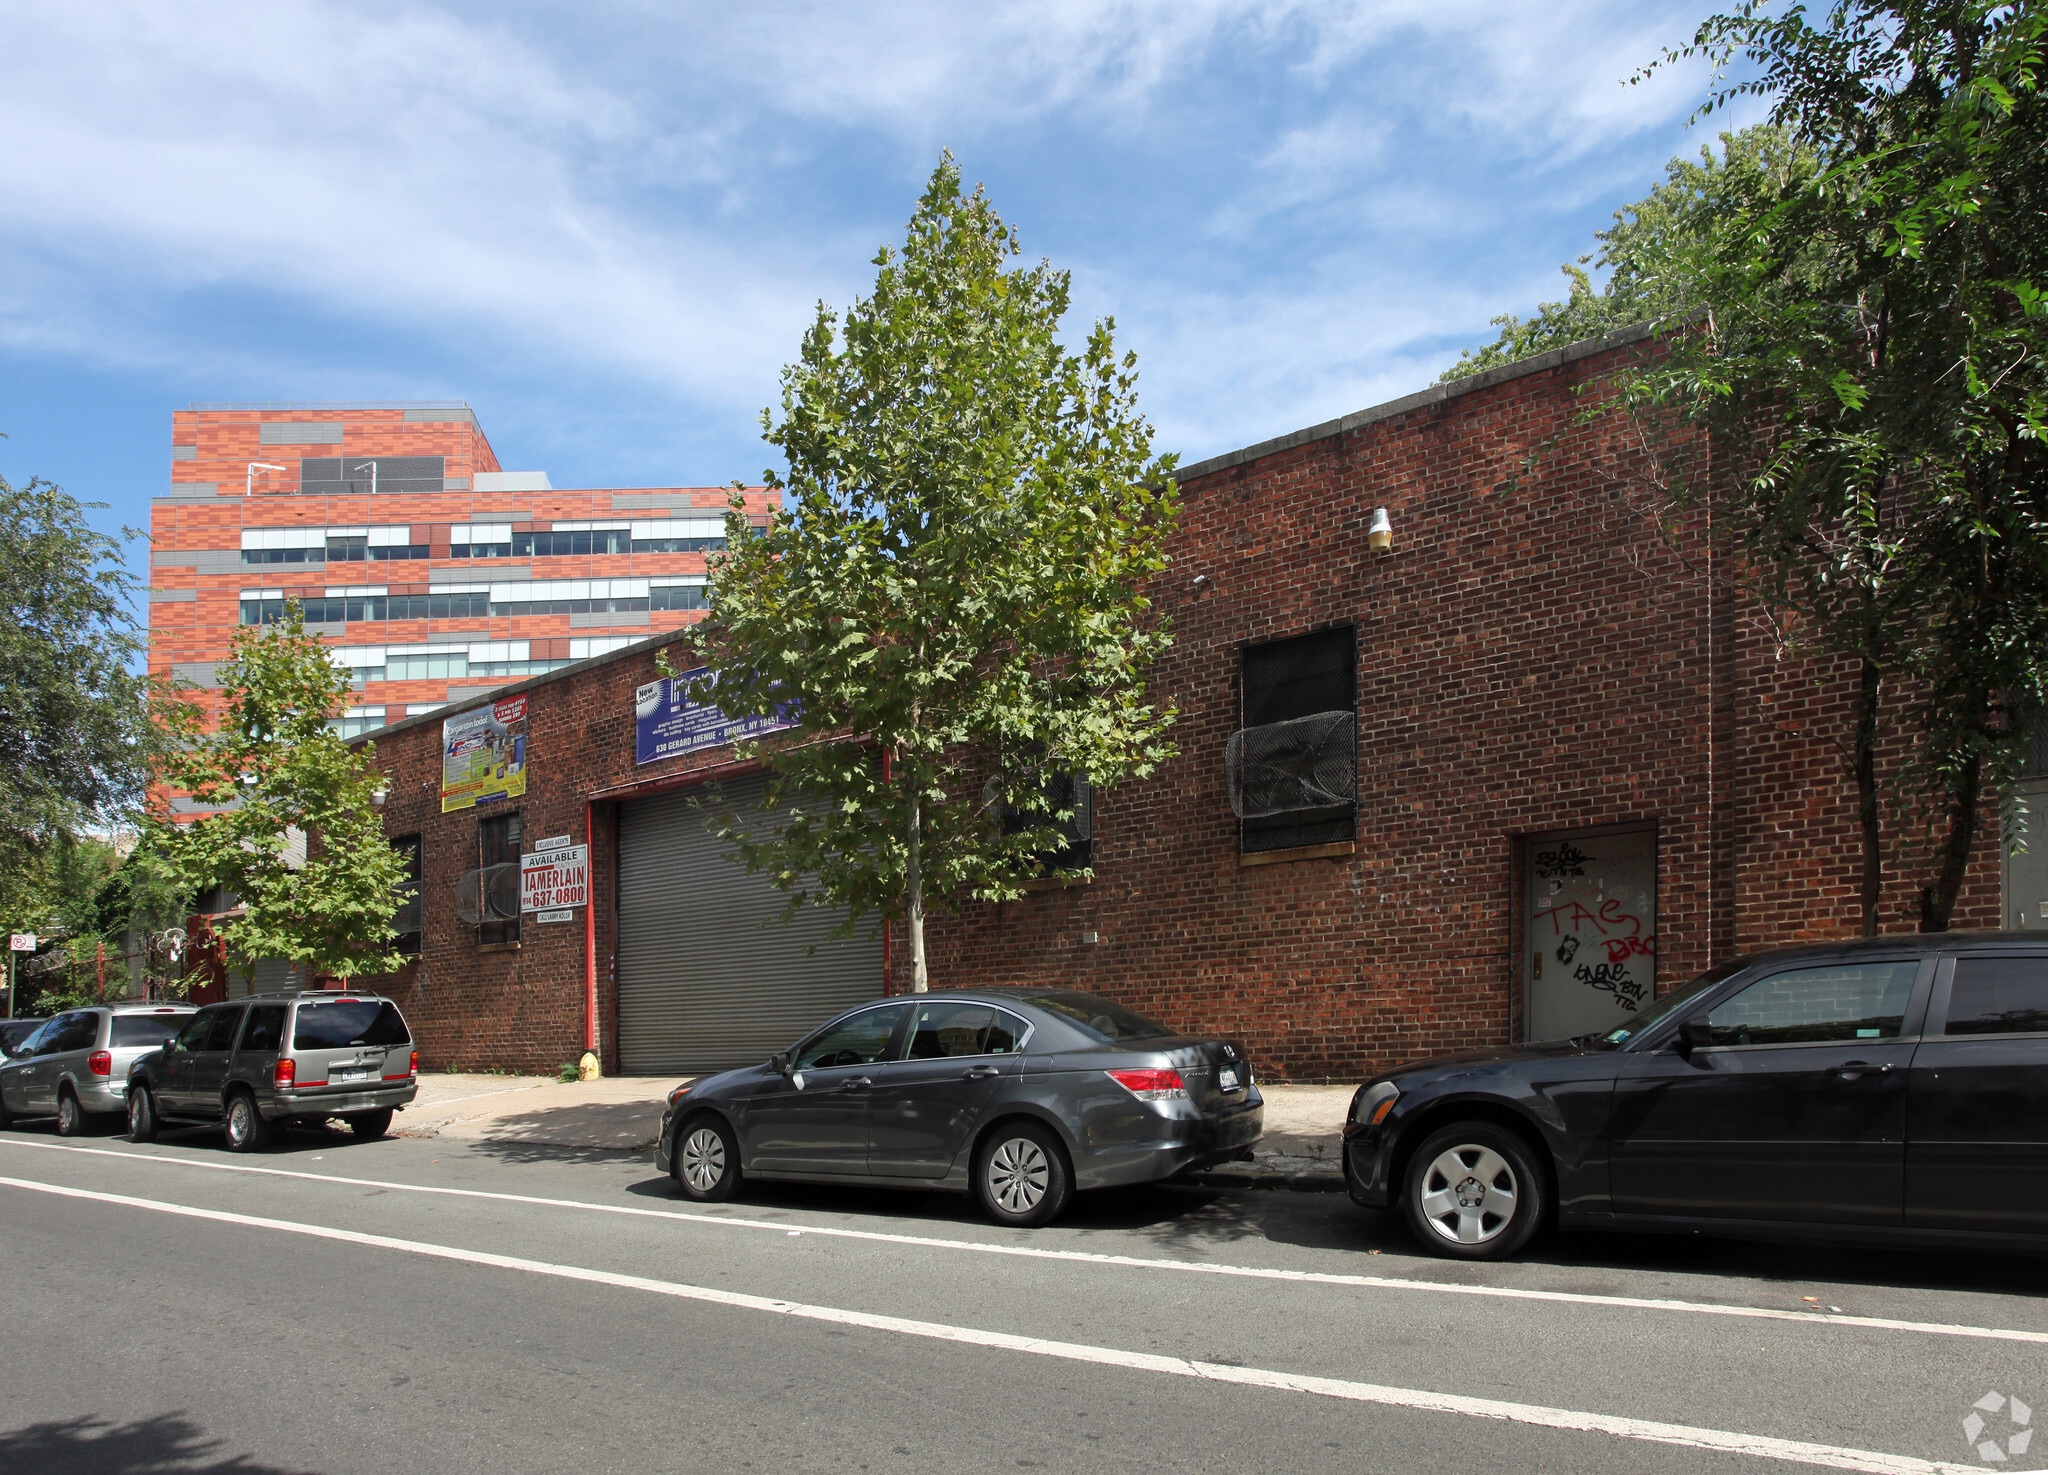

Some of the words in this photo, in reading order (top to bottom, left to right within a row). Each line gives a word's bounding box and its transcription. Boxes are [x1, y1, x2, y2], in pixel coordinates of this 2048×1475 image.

[636, 692, 658, 706] Location
[638, 686, 654, 698] New
[668, 737, 692, 750] GERARD
[692, 730, 717, 744] AVENUE
[748, 720, 758, 731] NY
[759, 715, 780, 728] 10451
[529, 851, 578, 867] AVAILABLE
[523, 864, 585, 892] TAMERLAIN
[522, 896, 532, 905] 914
[533, 885, 585, 907] 637-0800
